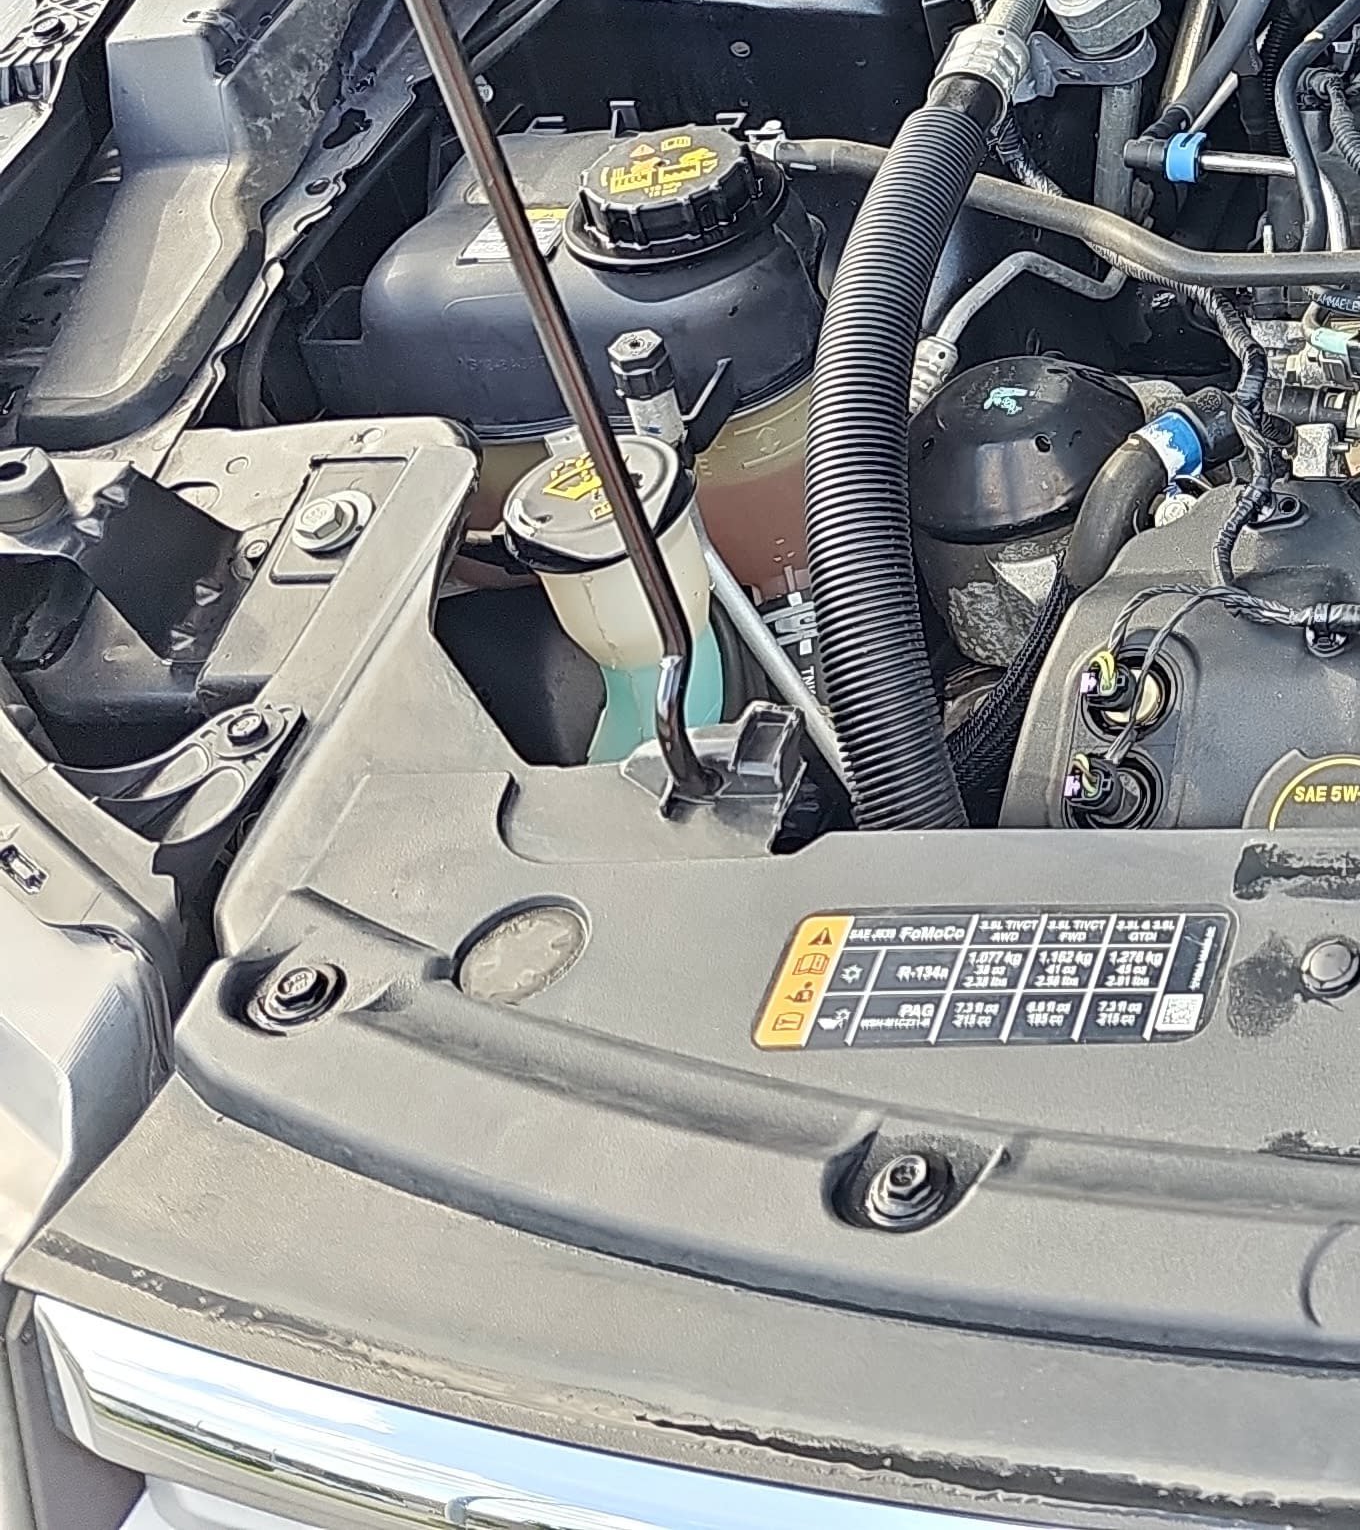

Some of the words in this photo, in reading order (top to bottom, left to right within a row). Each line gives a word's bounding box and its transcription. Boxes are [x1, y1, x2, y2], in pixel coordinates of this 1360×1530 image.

[1294, 785, 1328, 802] SAE
[899, 925, 967, 942] FoMoCo
[989, 932, 1020, 943] AWD
[1058, 932, 1088, 943] FWD
[968, 951, 1004, 967] 1.077
[1003, 951, 1024, 969] kg
[1074, 951, 1095, 969] kg
[1145, 951, 1164, 968] kg
